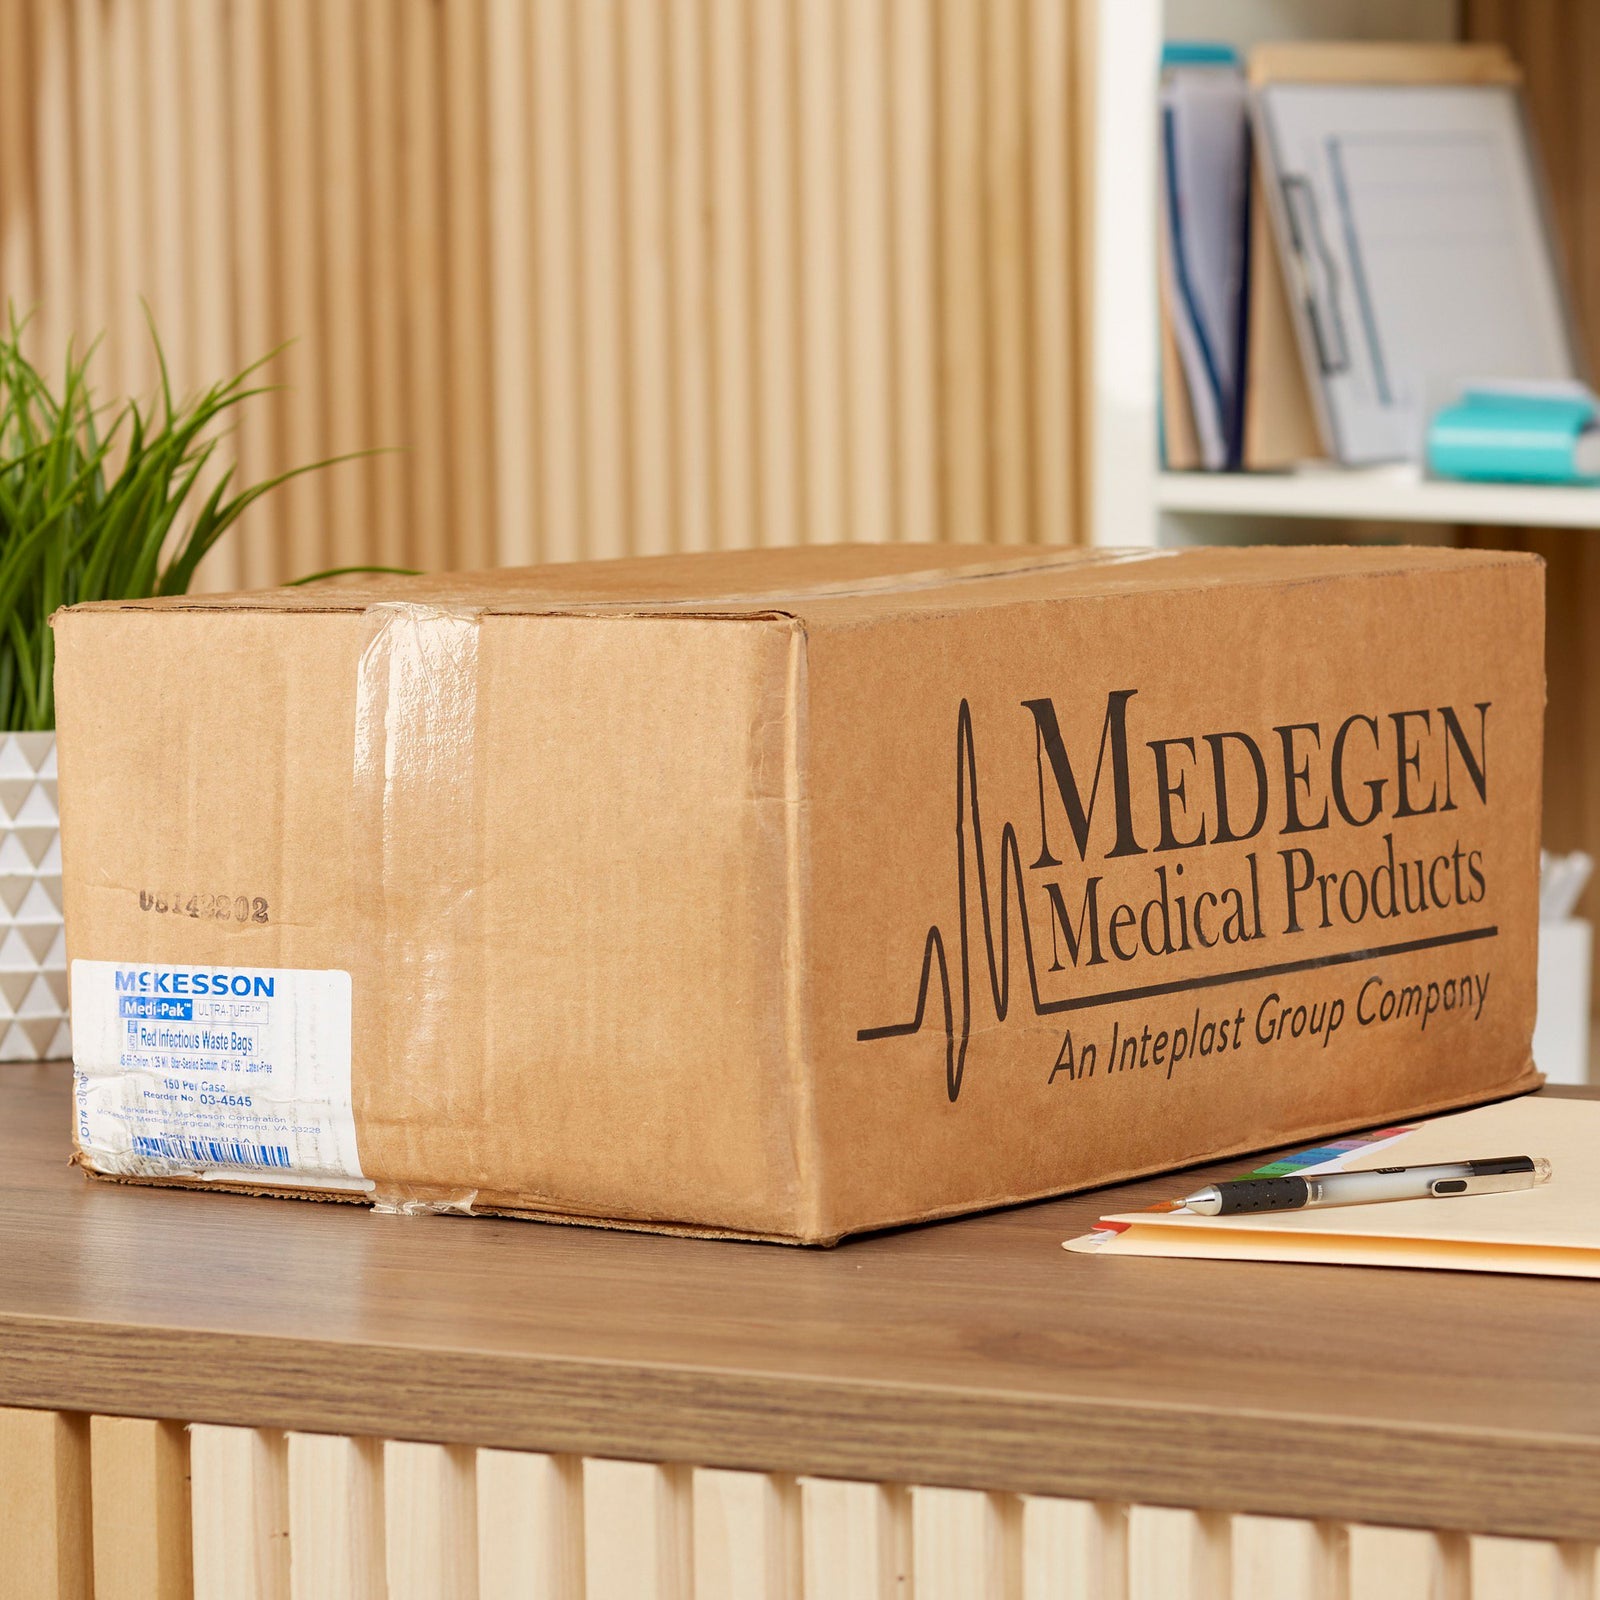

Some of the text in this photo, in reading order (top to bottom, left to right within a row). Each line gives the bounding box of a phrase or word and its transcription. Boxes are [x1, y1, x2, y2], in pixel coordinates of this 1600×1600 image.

[1021, 688, 1492, 870] MEDEGEN
[1042, 834, 1487, 973] Medical Products
[1048, 973, 1490, 1085] An Inteplast Group Company
[141, 1028, 157, 1047] Red
[159, 1028, 200, 1049] Infectious
[202, 1031, 228, 1050] Waste
[231, 1032, 253, 1056] Bags
[164, 1079, 180, 1090] 150
[183, 1080, 198, 1091] Per
[144, 1091, 178, 1101] Reorder
[200, 1094, 252, 1107] 03-4545
[228, 1114, 287, 1125] Corporation
[273, 1124, 288, 1132] VA
